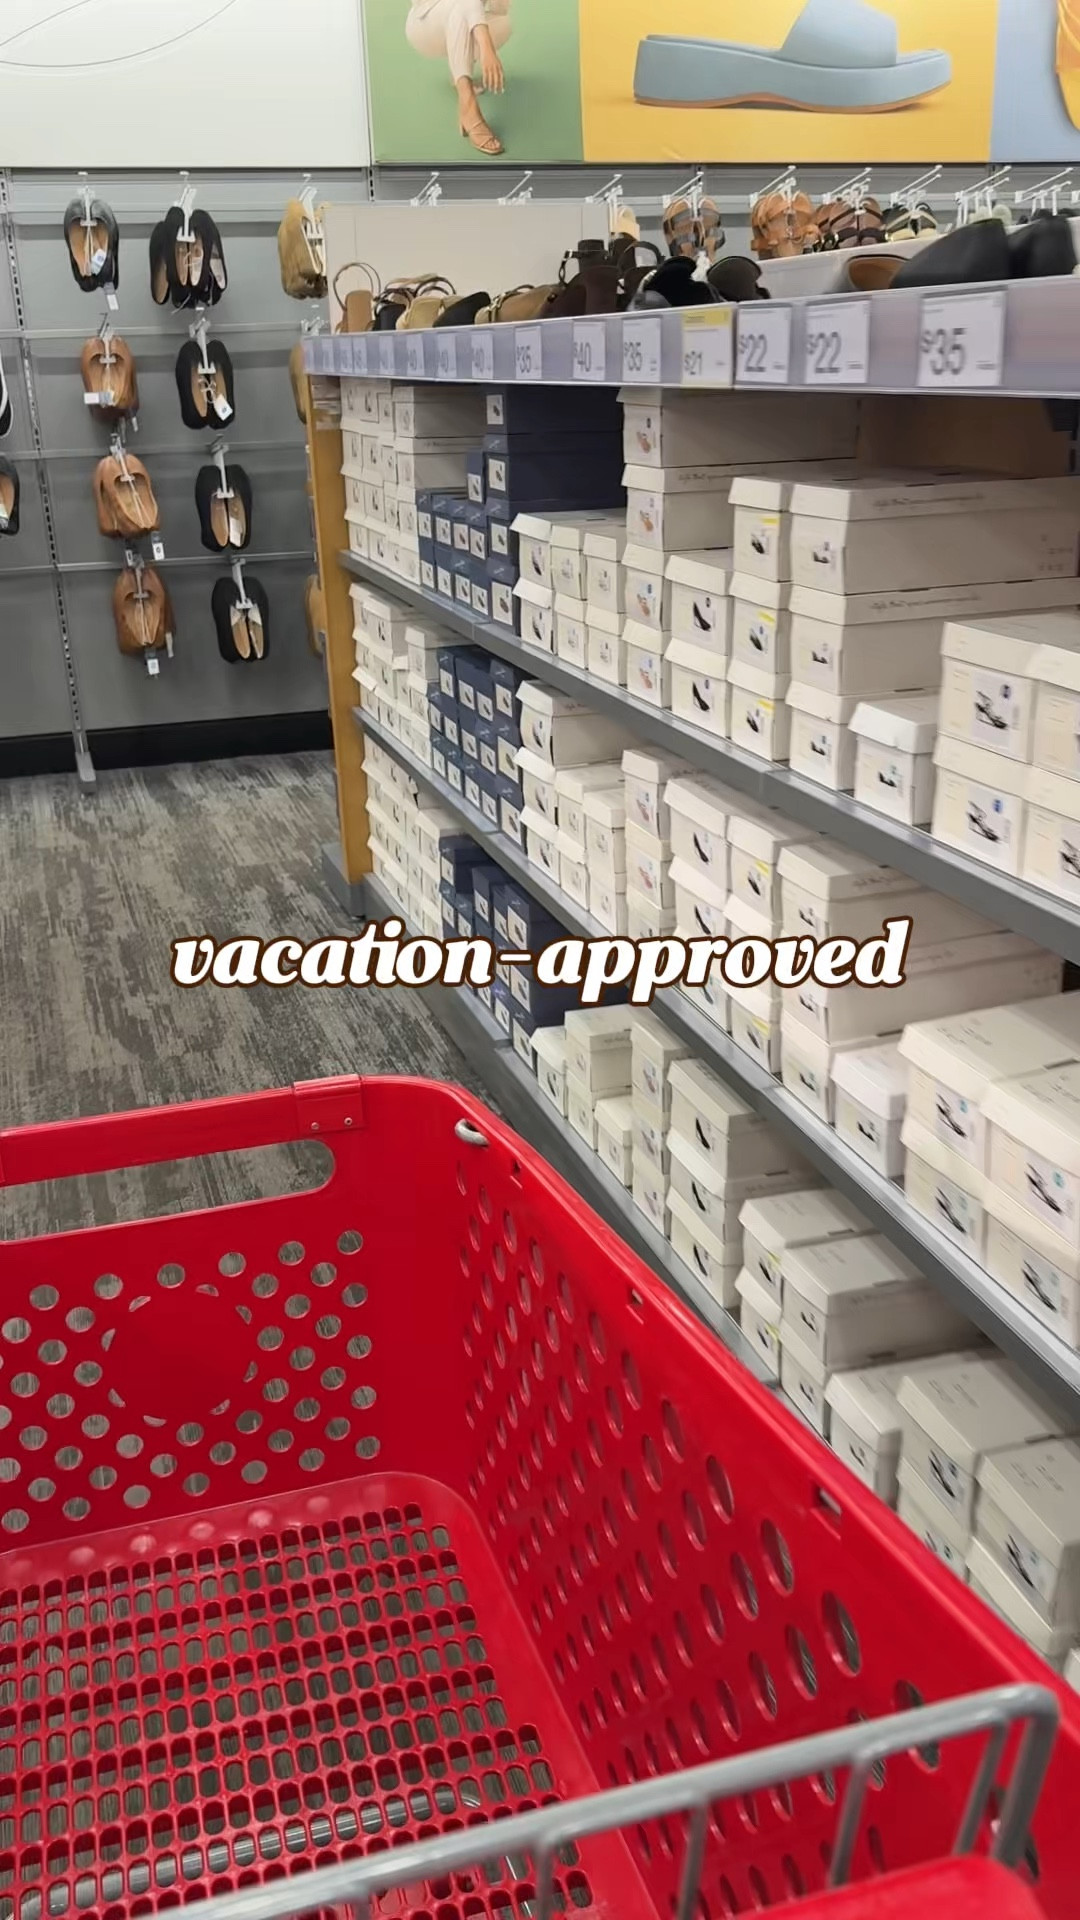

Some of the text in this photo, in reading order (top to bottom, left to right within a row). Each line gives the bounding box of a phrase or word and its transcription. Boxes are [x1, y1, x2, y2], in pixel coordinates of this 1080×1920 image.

[574, 342, 592, 372] $40
[624, 341, 643, 371] $35
[684, 351, 702, 375] $21
[737, 334, 767, 372] $22
[807, 331, 842, 373] $22
[921, 327, 966, 375] $35
